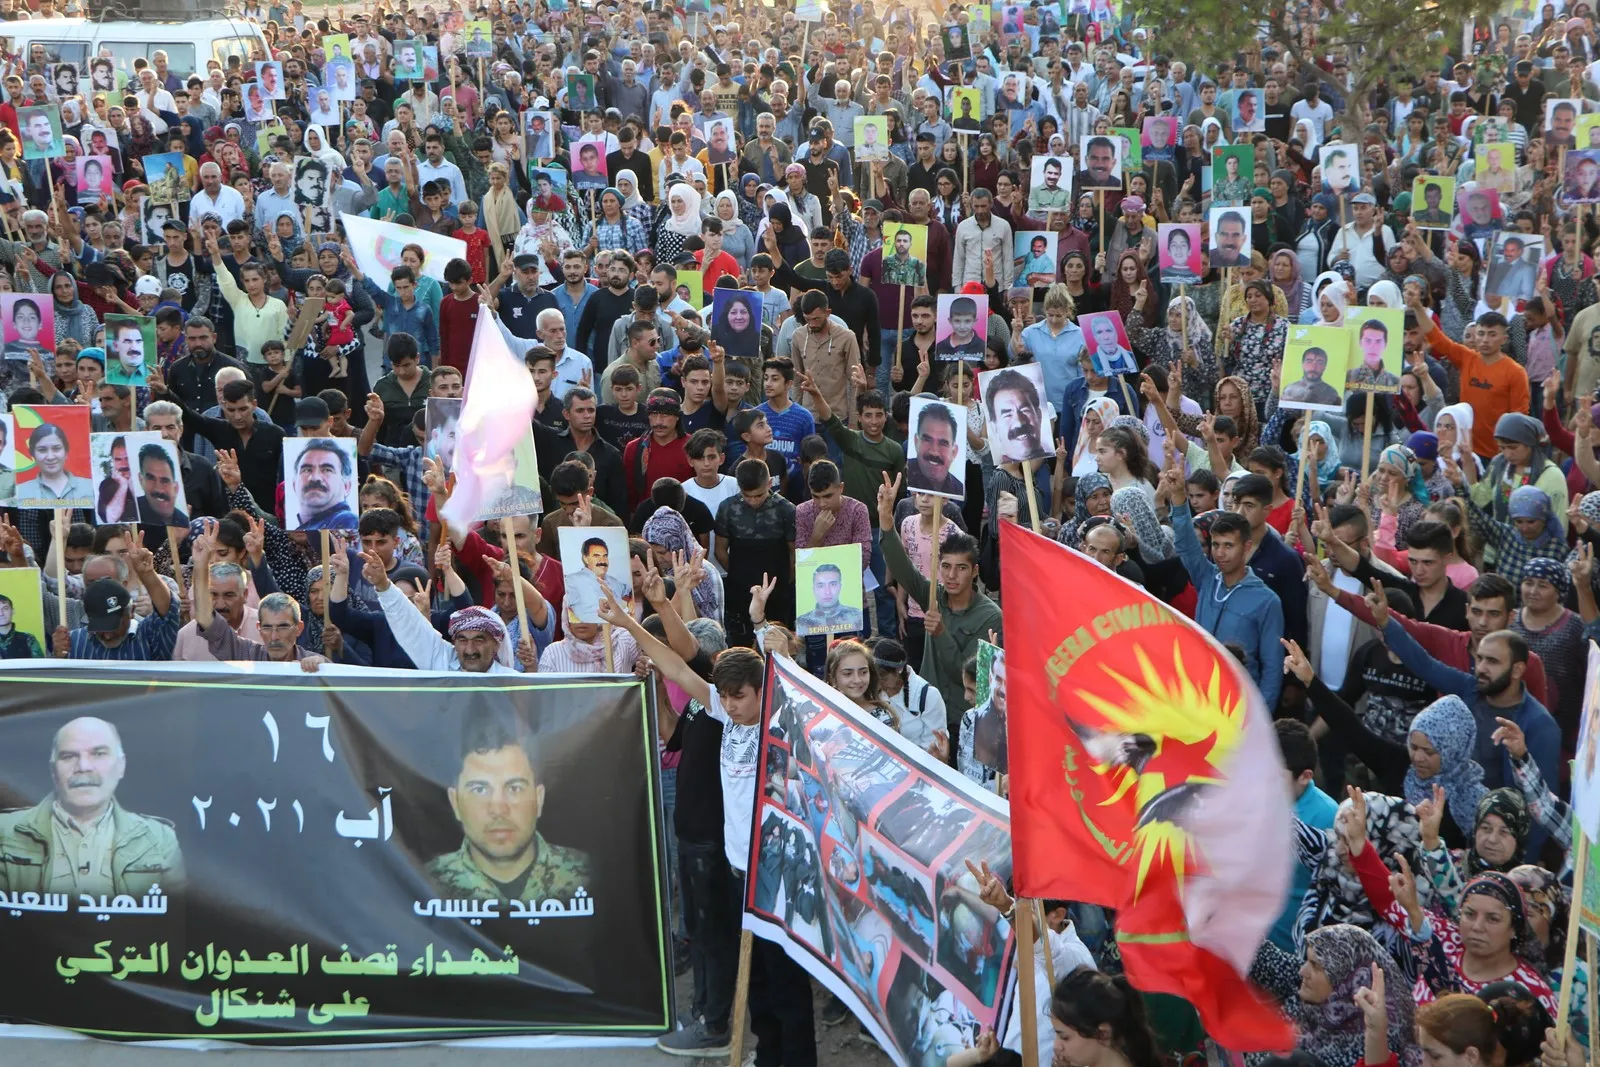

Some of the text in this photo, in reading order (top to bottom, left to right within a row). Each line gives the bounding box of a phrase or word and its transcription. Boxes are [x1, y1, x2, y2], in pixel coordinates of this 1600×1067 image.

[763, 439, 795, 453] EDIUM
[192, 786, 394, 848] آب ٢٠٢١
[78, 883, 168, 921] شهيد
[413, 885, 595, 926] شهيد عيسى
[56, 939, 520, 984] شهداء قصف العدوان التركي
[195, 987, 371, 1027] على شنكال
